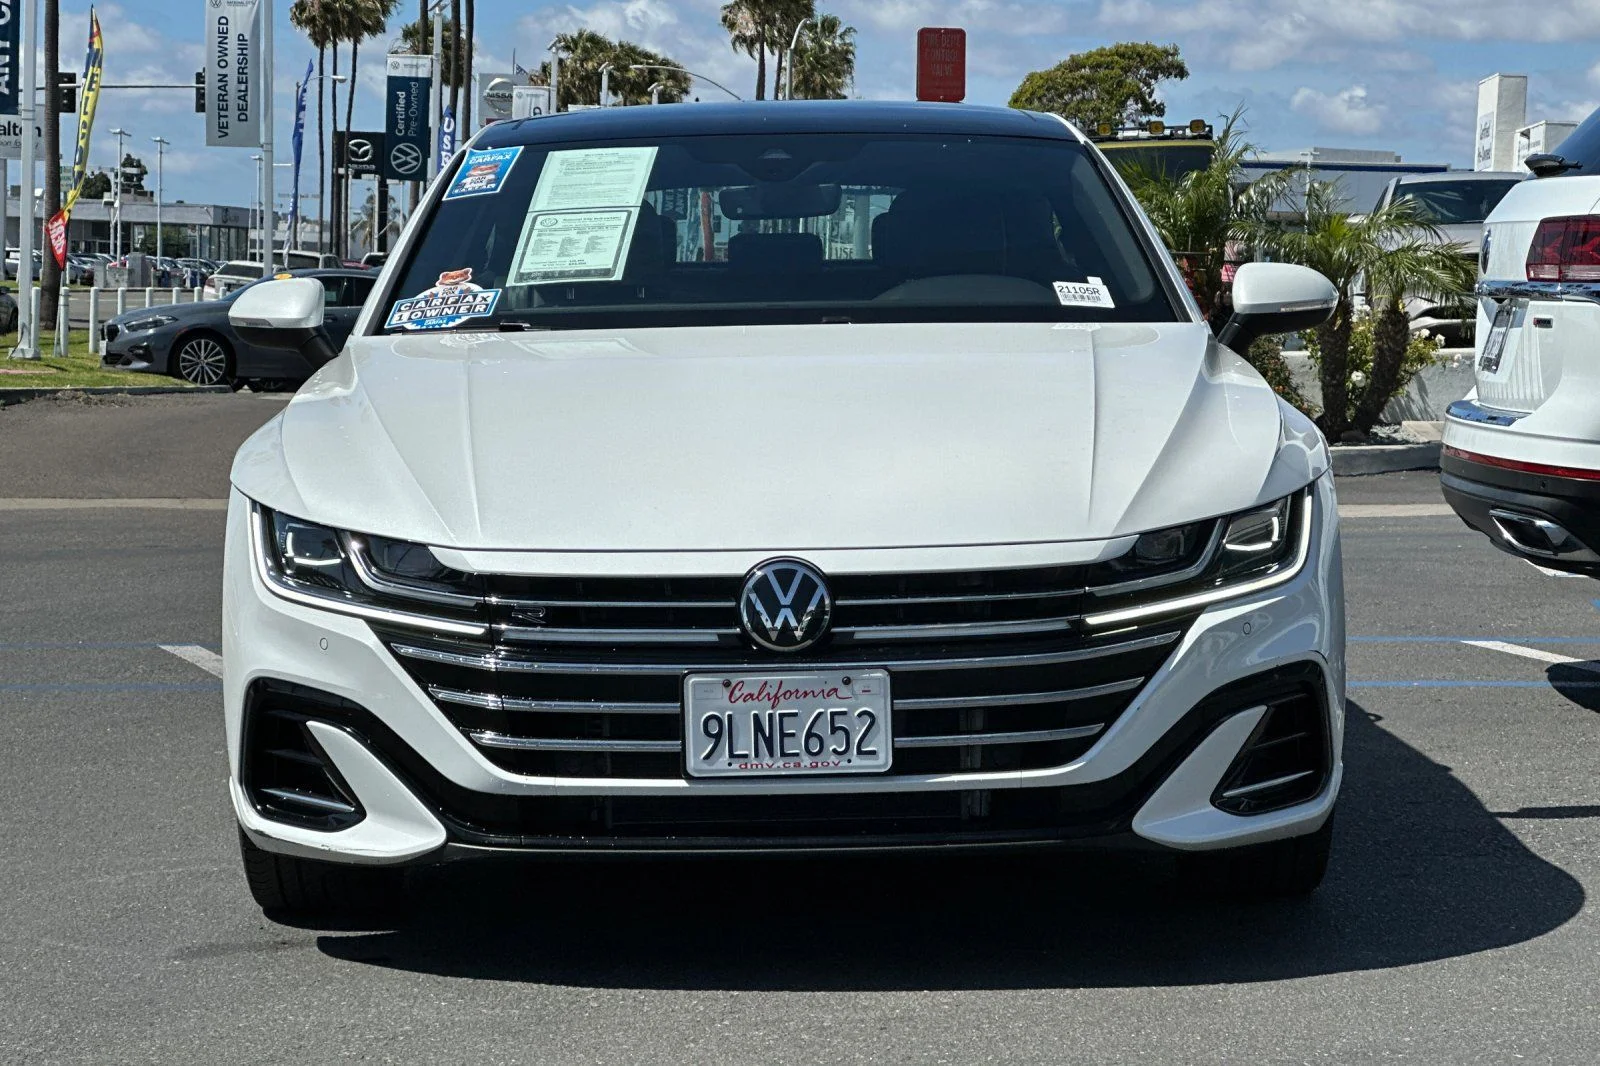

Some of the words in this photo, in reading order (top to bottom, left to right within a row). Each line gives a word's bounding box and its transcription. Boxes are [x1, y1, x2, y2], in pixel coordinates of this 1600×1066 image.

[217, 15, 229, 69] OWNED
[237, 33, 249, 122] DEALERSHIP
[217, 73, 229, 139] VETERAN
[395, 91, 406, 136] Certified
[408, 81, 419, 137] Pre-Owned
[440, 117, 455, 170] USE
[395, 313, 404, 321] 1
[410, 304, 487, 320] OWNER
[400, 295, 491, 311] CARFAX
[1057, 285, 1101, 295] 21105R
[728, 680, 853, 709] California
[701, 707, 878, 760] 9LNE652
[738, 759, 841, 770] dmv.ca.gov
